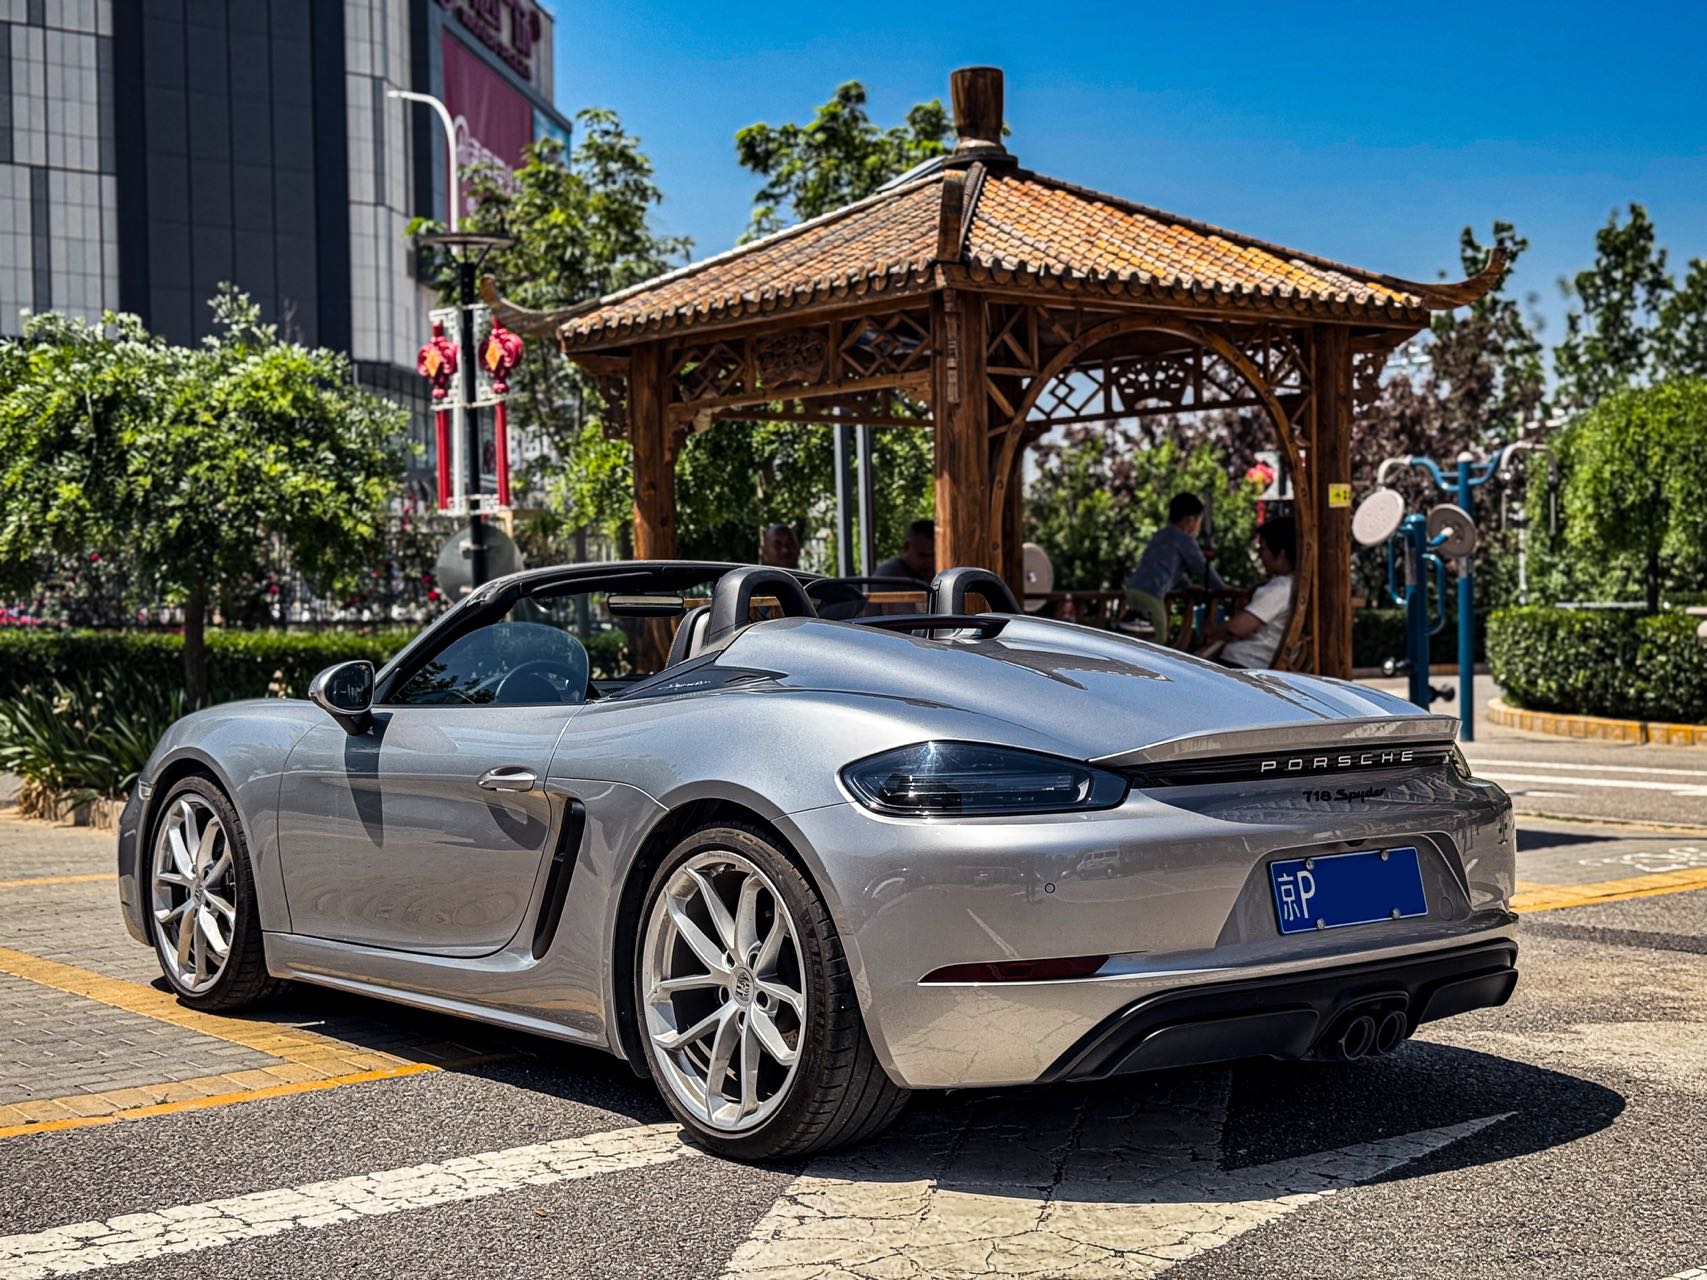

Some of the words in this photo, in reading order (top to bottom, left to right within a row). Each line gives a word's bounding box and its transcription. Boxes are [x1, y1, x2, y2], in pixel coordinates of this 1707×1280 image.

[1260, 750, 1413, 772] PORSCHE
[1303, 790, 1332, 803] 718
[1334, 786, 1386, 803] Spyder
[1277, 870, 1316, 921] 京P
